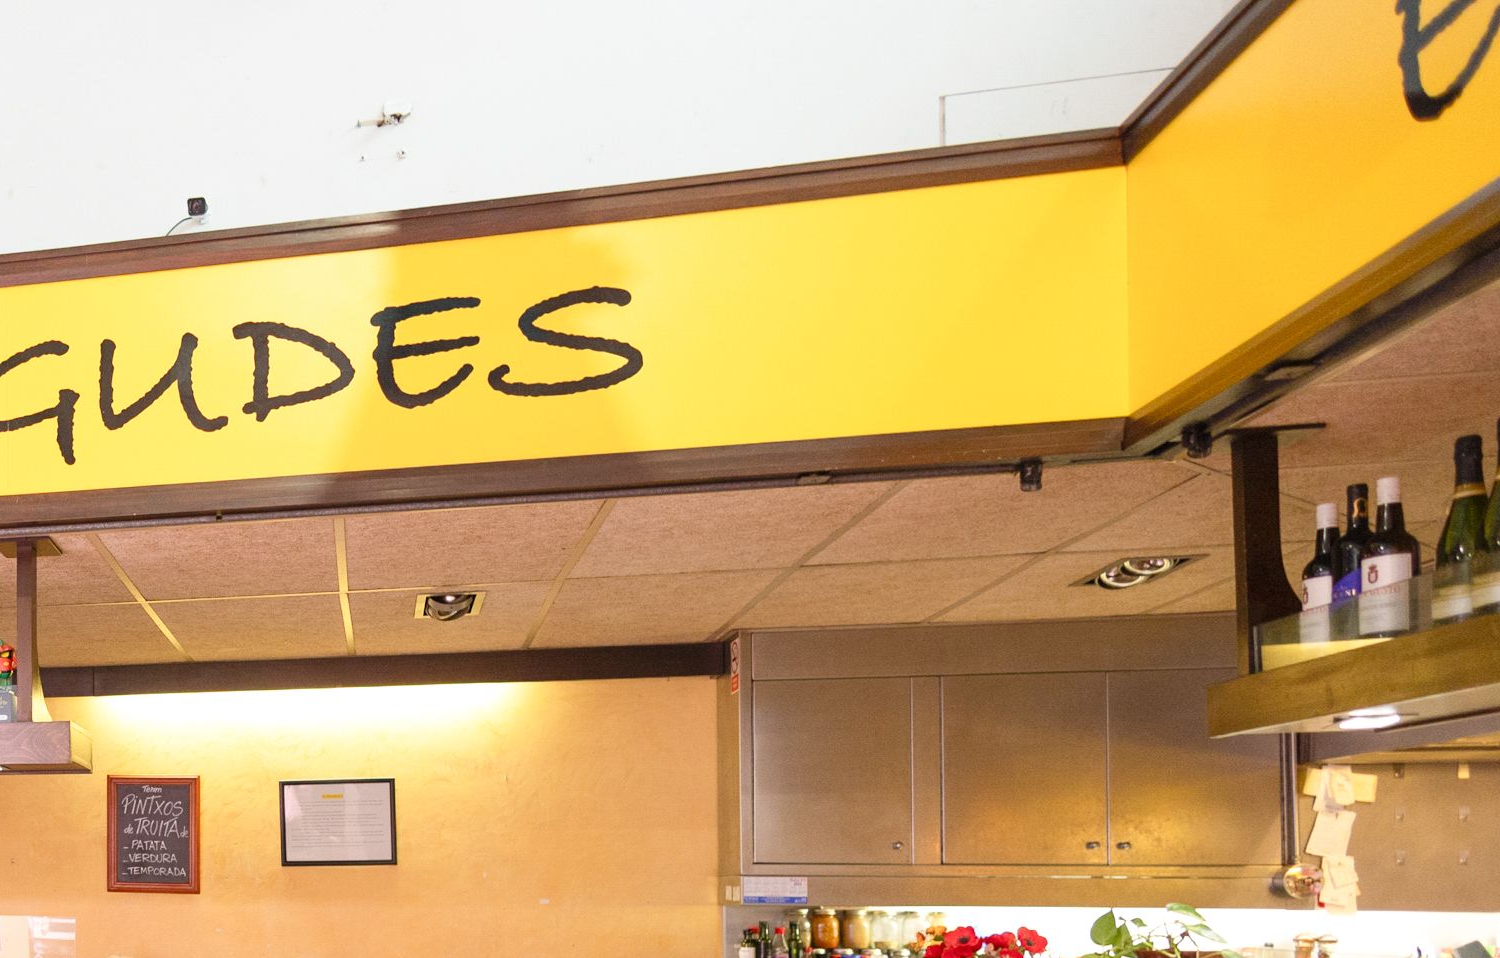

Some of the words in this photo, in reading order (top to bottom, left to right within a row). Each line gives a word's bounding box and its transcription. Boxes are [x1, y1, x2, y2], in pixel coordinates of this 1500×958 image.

[121, 793, 184, 817] PINTXOS
[134, 816, 180, 838] TRUITA
[131, 839, 167, 851] PATATA
[128, 852, 177, 863] VERDURA
[127, 866, 186, 877] TEMPORADA
